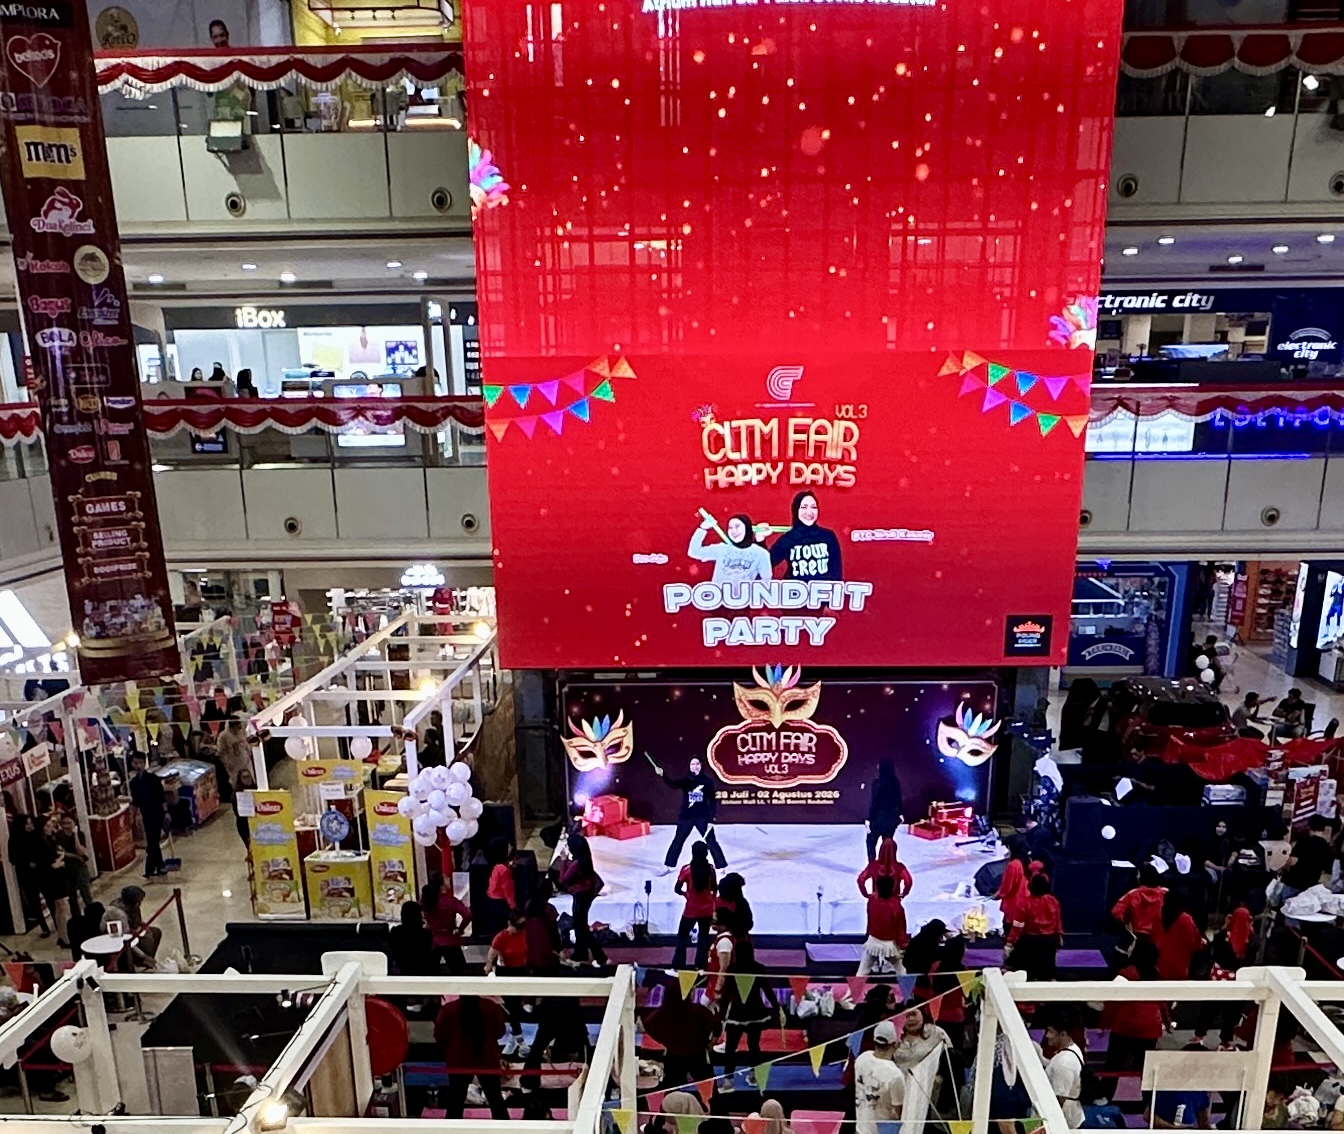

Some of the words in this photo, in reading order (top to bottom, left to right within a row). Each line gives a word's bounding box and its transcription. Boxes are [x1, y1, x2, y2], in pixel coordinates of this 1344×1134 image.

[1172, 292, 1215, 310] city
[236, 306, 286, 328] iBox
[1277, 341, 1337, 351] electronic
[1294, 349, 1319, 360] city
[702, 417, 780, 462] CLTM
[787, 417, 860, 462] FAIR
[705, 462, 784, 489] HAPPY
[790, 462, 857, 488] DAYS
[86, 501, 126, 514] GAMES
[664, 580, 873, 612] POUNDFIT
[703, 617, 836, 646] PARTY
[737, 732, 776, 752] CLTM
[780, 731, 818, 752] FAIR
[737, 753, 778, 766] HAPPY
[781, 753, 816, 765] DAYS
[730, 790, 749, 799] Juli
[771, 790, 813, 802] Agustus
